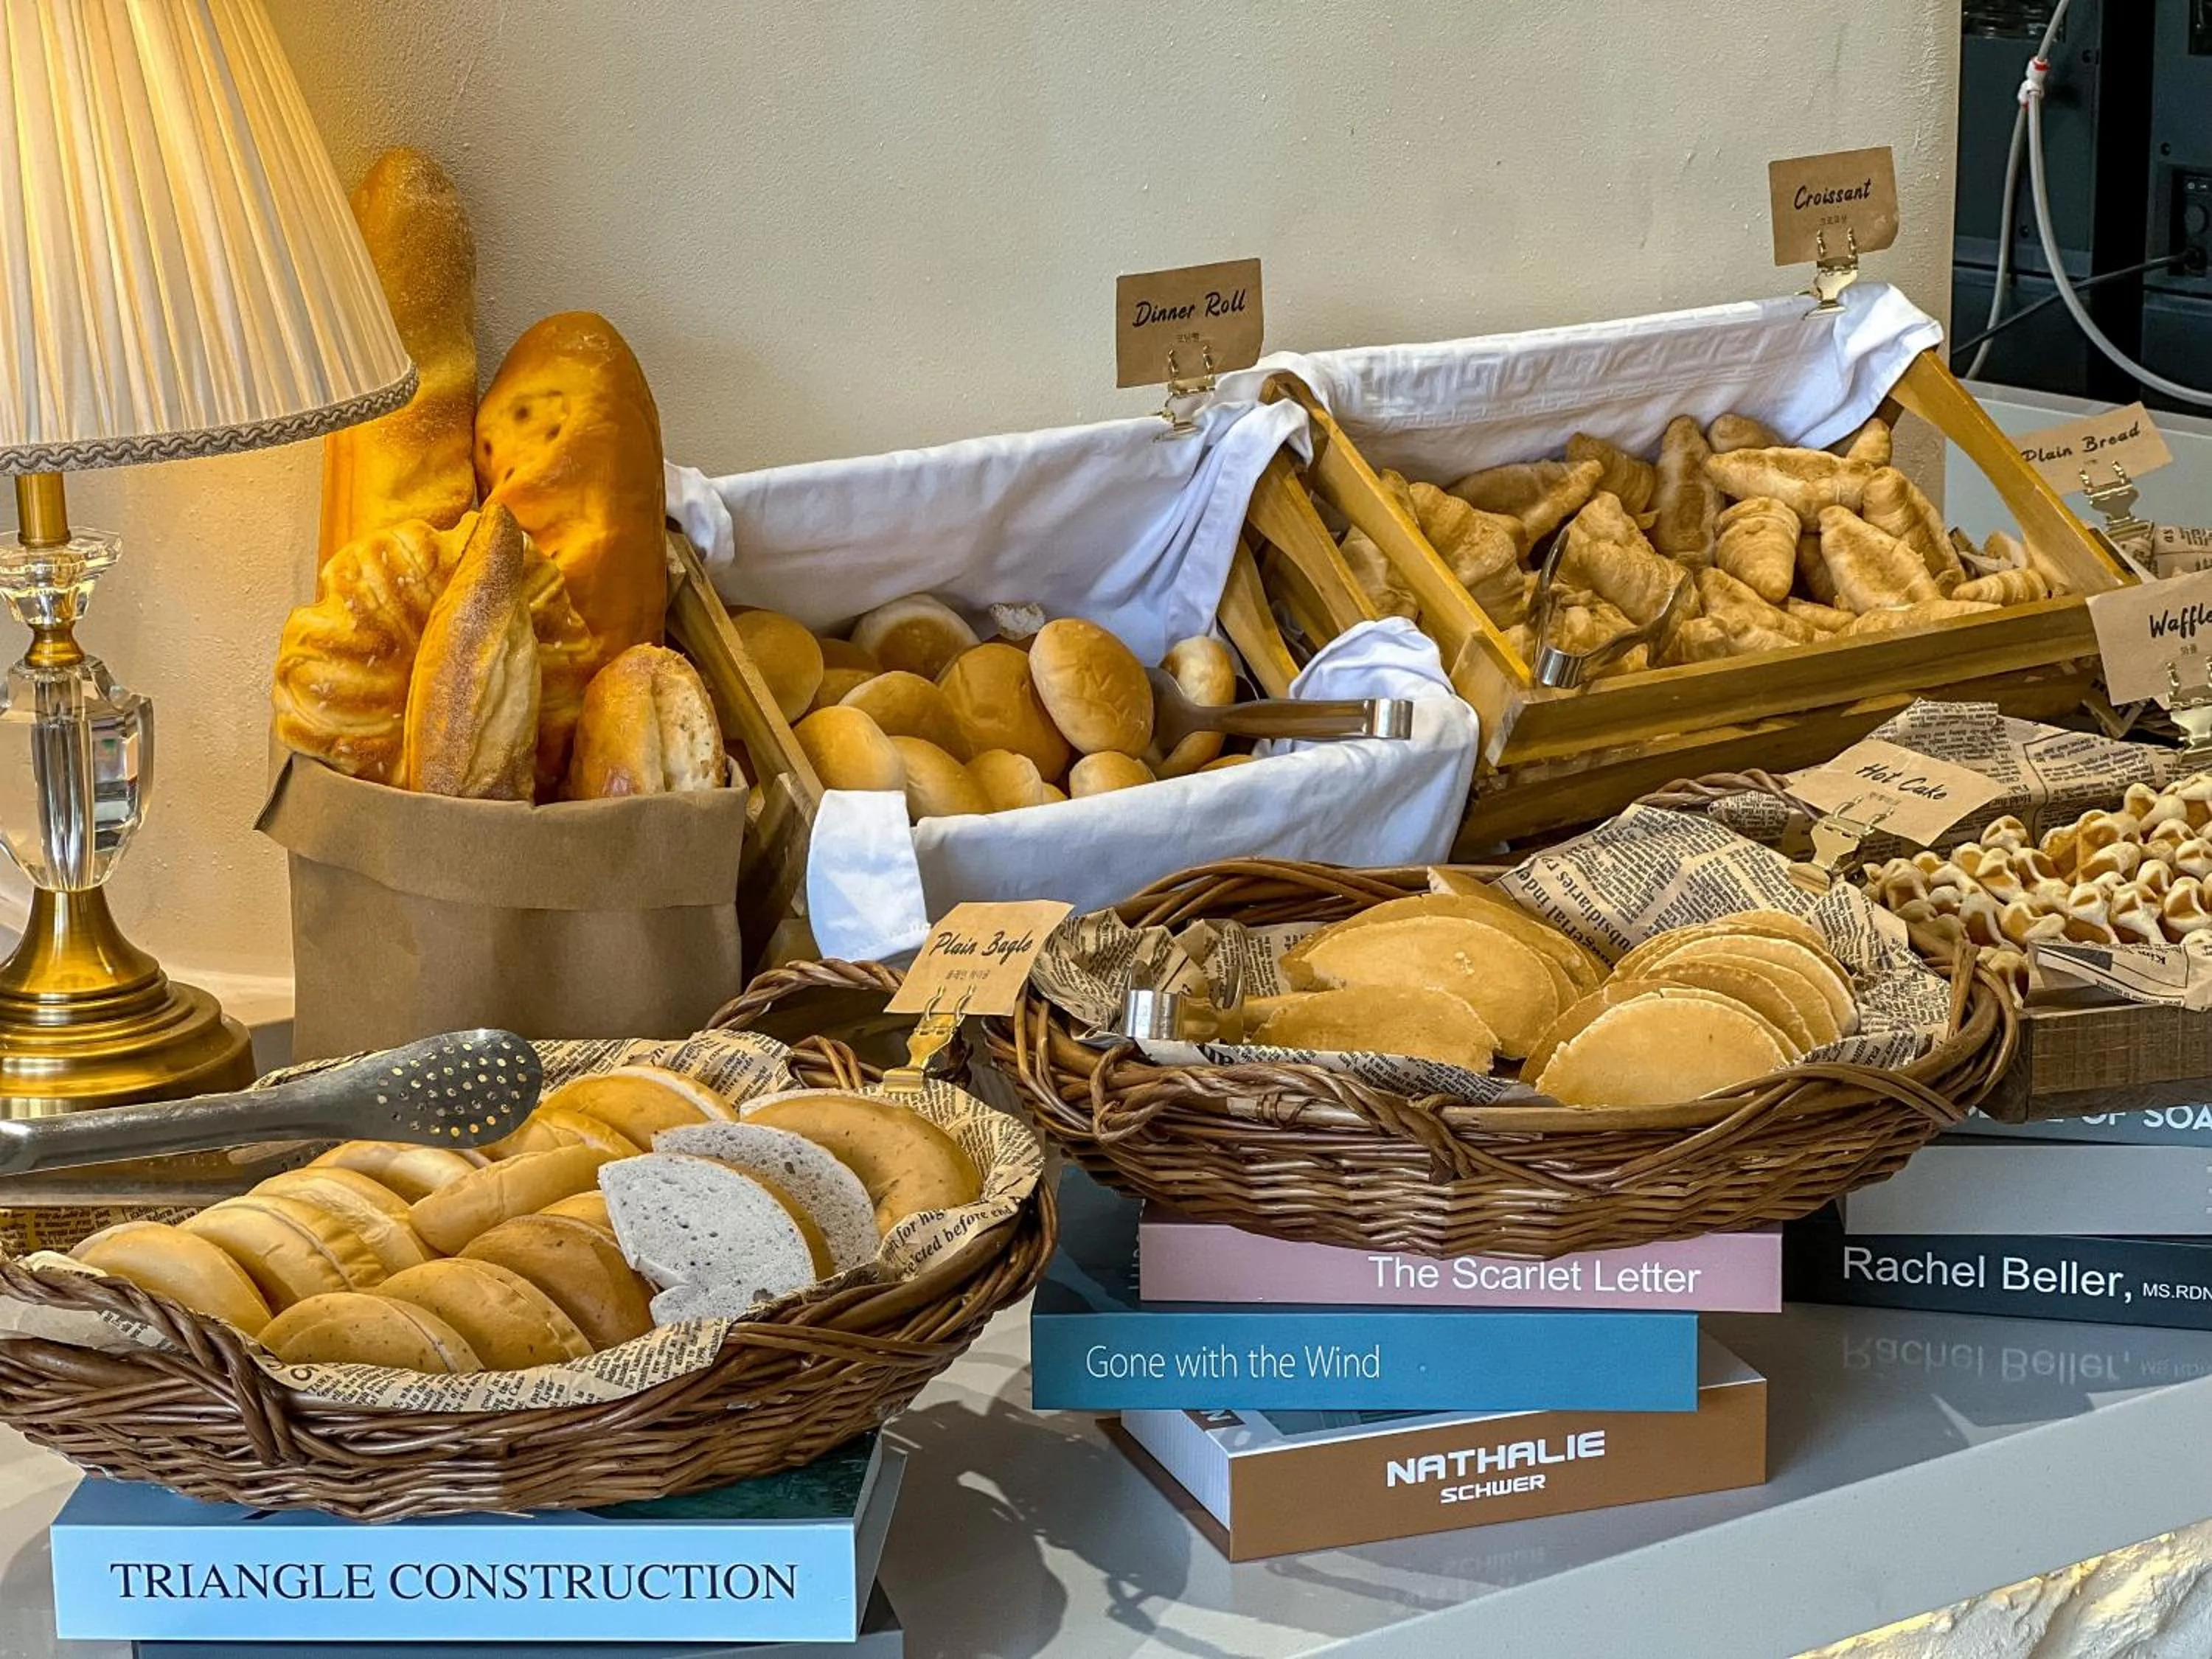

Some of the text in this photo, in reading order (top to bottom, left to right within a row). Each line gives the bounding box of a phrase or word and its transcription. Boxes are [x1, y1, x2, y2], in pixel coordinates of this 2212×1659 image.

[1794, 178, 1871, 210] Croissant
[1132, 288, 1246, 327] Dinner Roll
[2022, 420, 2142, 462] Plain Bread
[1855, 762, 1902, 783] Hot
[1899, 778, 1947, 800] Cake
[1557, 871, 1635, 952] ubsidiaries
[929, 929, 1034, 965] Plain Bagle
[943, 1211, 988, 1243] before
[1368, 1256, 1702, 1294] The Scarlet Letter
[1843, 1246, 1985, 1288] Rachel
[2002, 1256, 2133, 1304] Beller,
[1086, 1344, 1381, 1378] Gone with the Wind
[1385, 1429, 1605, 1488] NATHALIE
[1439, 1473, 1545, 1505] SCHWER
[110, 1562, 799, 1601] TRIANGLE CONSTRUCTION
